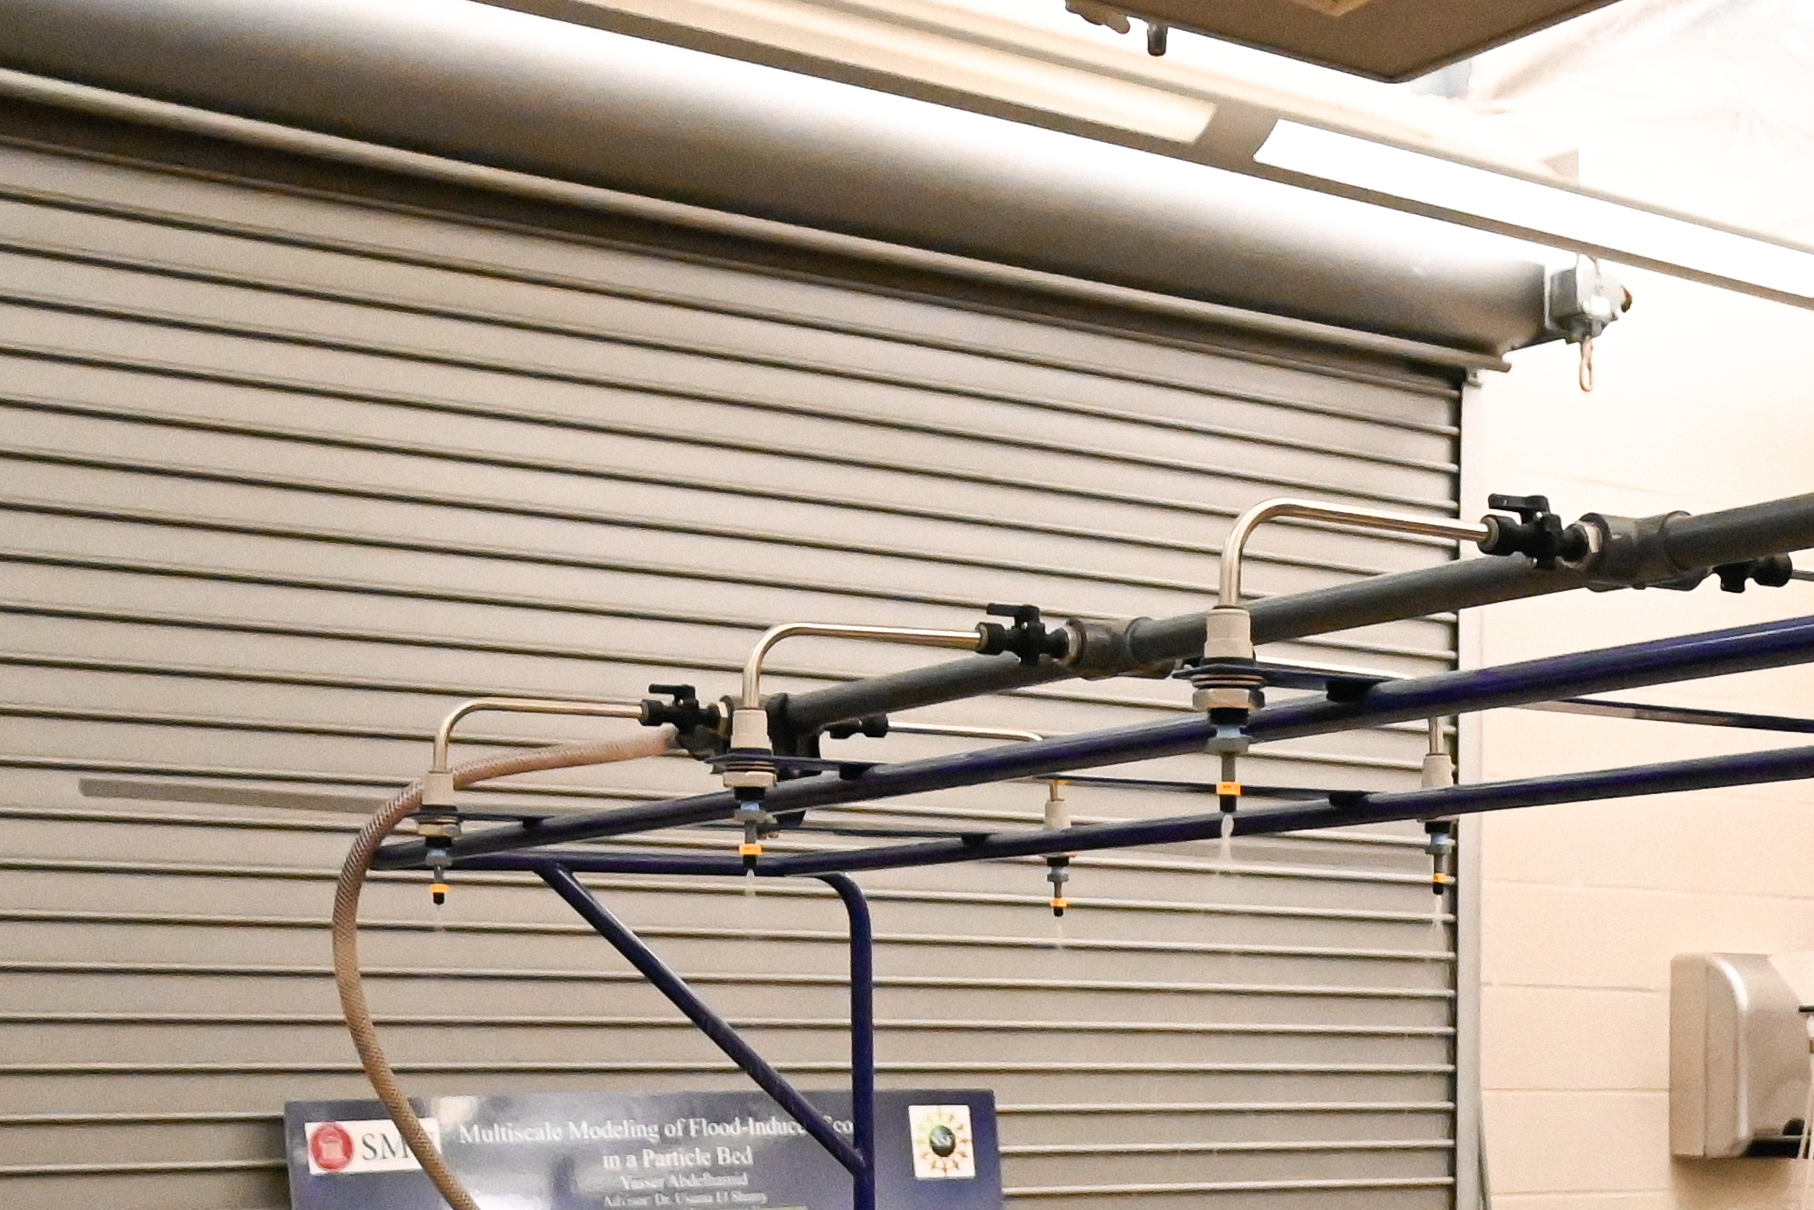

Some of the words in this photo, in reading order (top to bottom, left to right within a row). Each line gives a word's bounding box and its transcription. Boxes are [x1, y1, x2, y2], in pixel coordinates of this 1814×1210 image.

[459, 1121, 563, 1143] Multiscale
[568, 1119, 661, 1143] Modeling
[664, 1117, 686, 1136] of
[690, 1115, 807, 1137] Flood-Induce
[361, 1131, 418, 1160] SM
[603, 1150, 621, 1168] in
[626, 1155, 638, 1168] a
[642, 1148, 712, 1168] Particle
[717, 1145, 754, 1166] Bed
